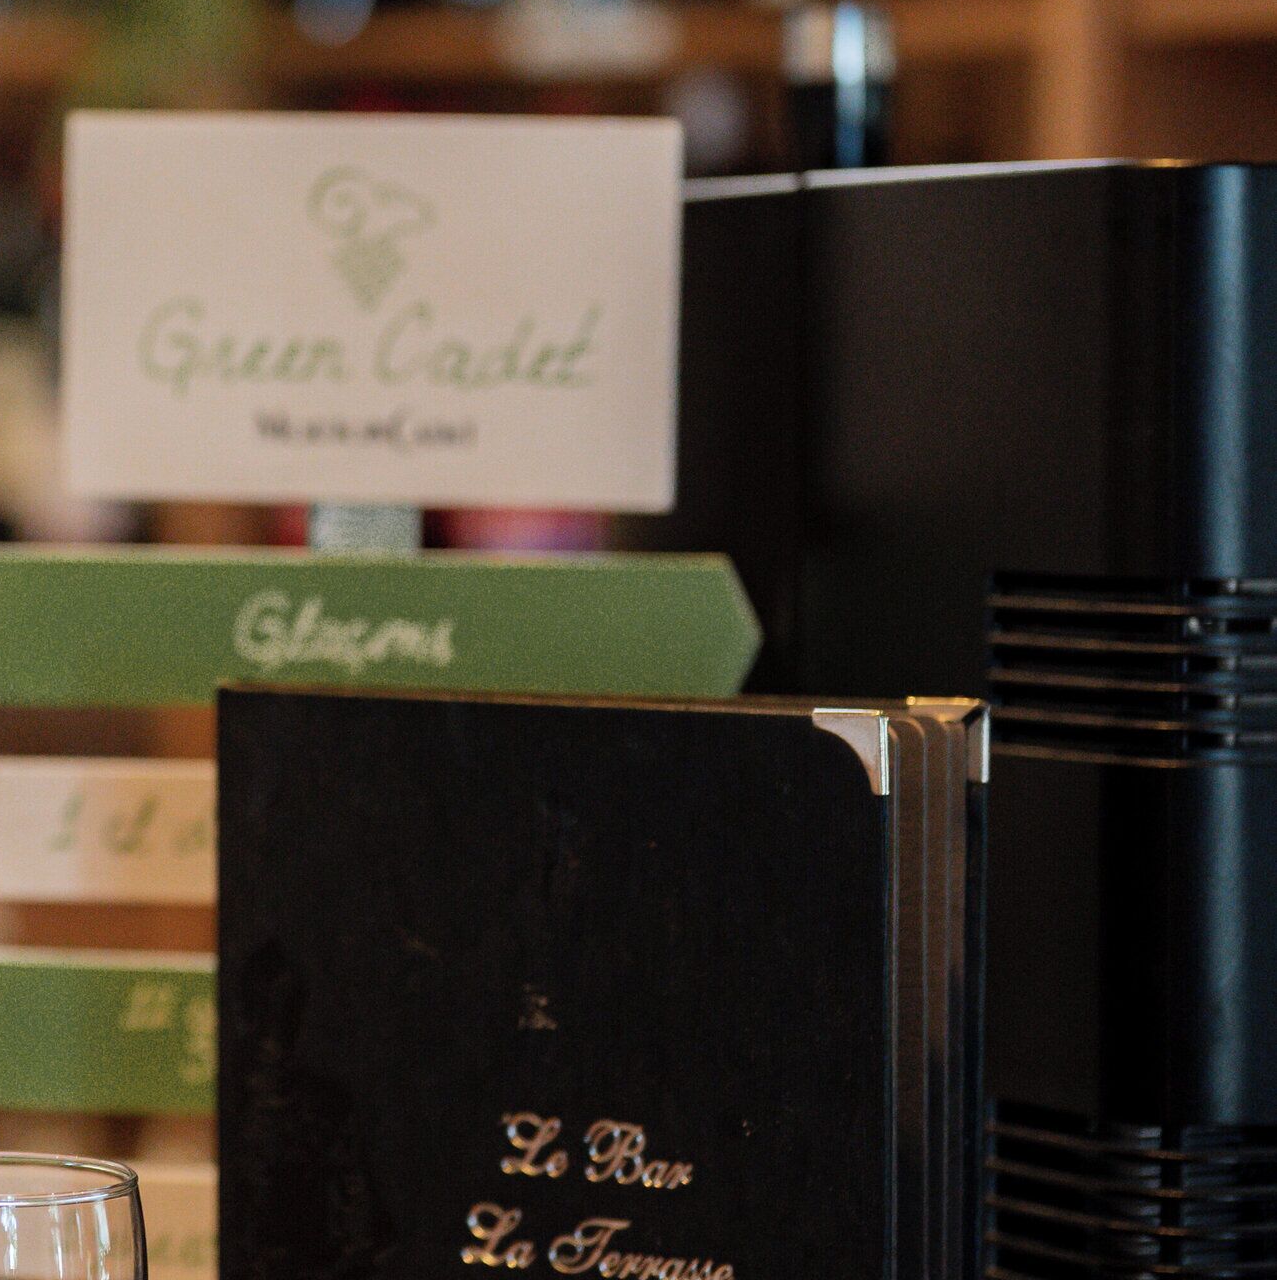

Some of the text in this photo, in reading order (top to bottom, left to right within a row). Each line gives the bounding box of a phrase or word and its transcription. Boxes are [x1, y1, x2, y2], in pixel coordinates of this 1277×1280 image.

[136, 296, 599, 397] Green Cadet
[500, 1111, 693, 1189] Le Bar
[460, 1202, 536, 1269] La
